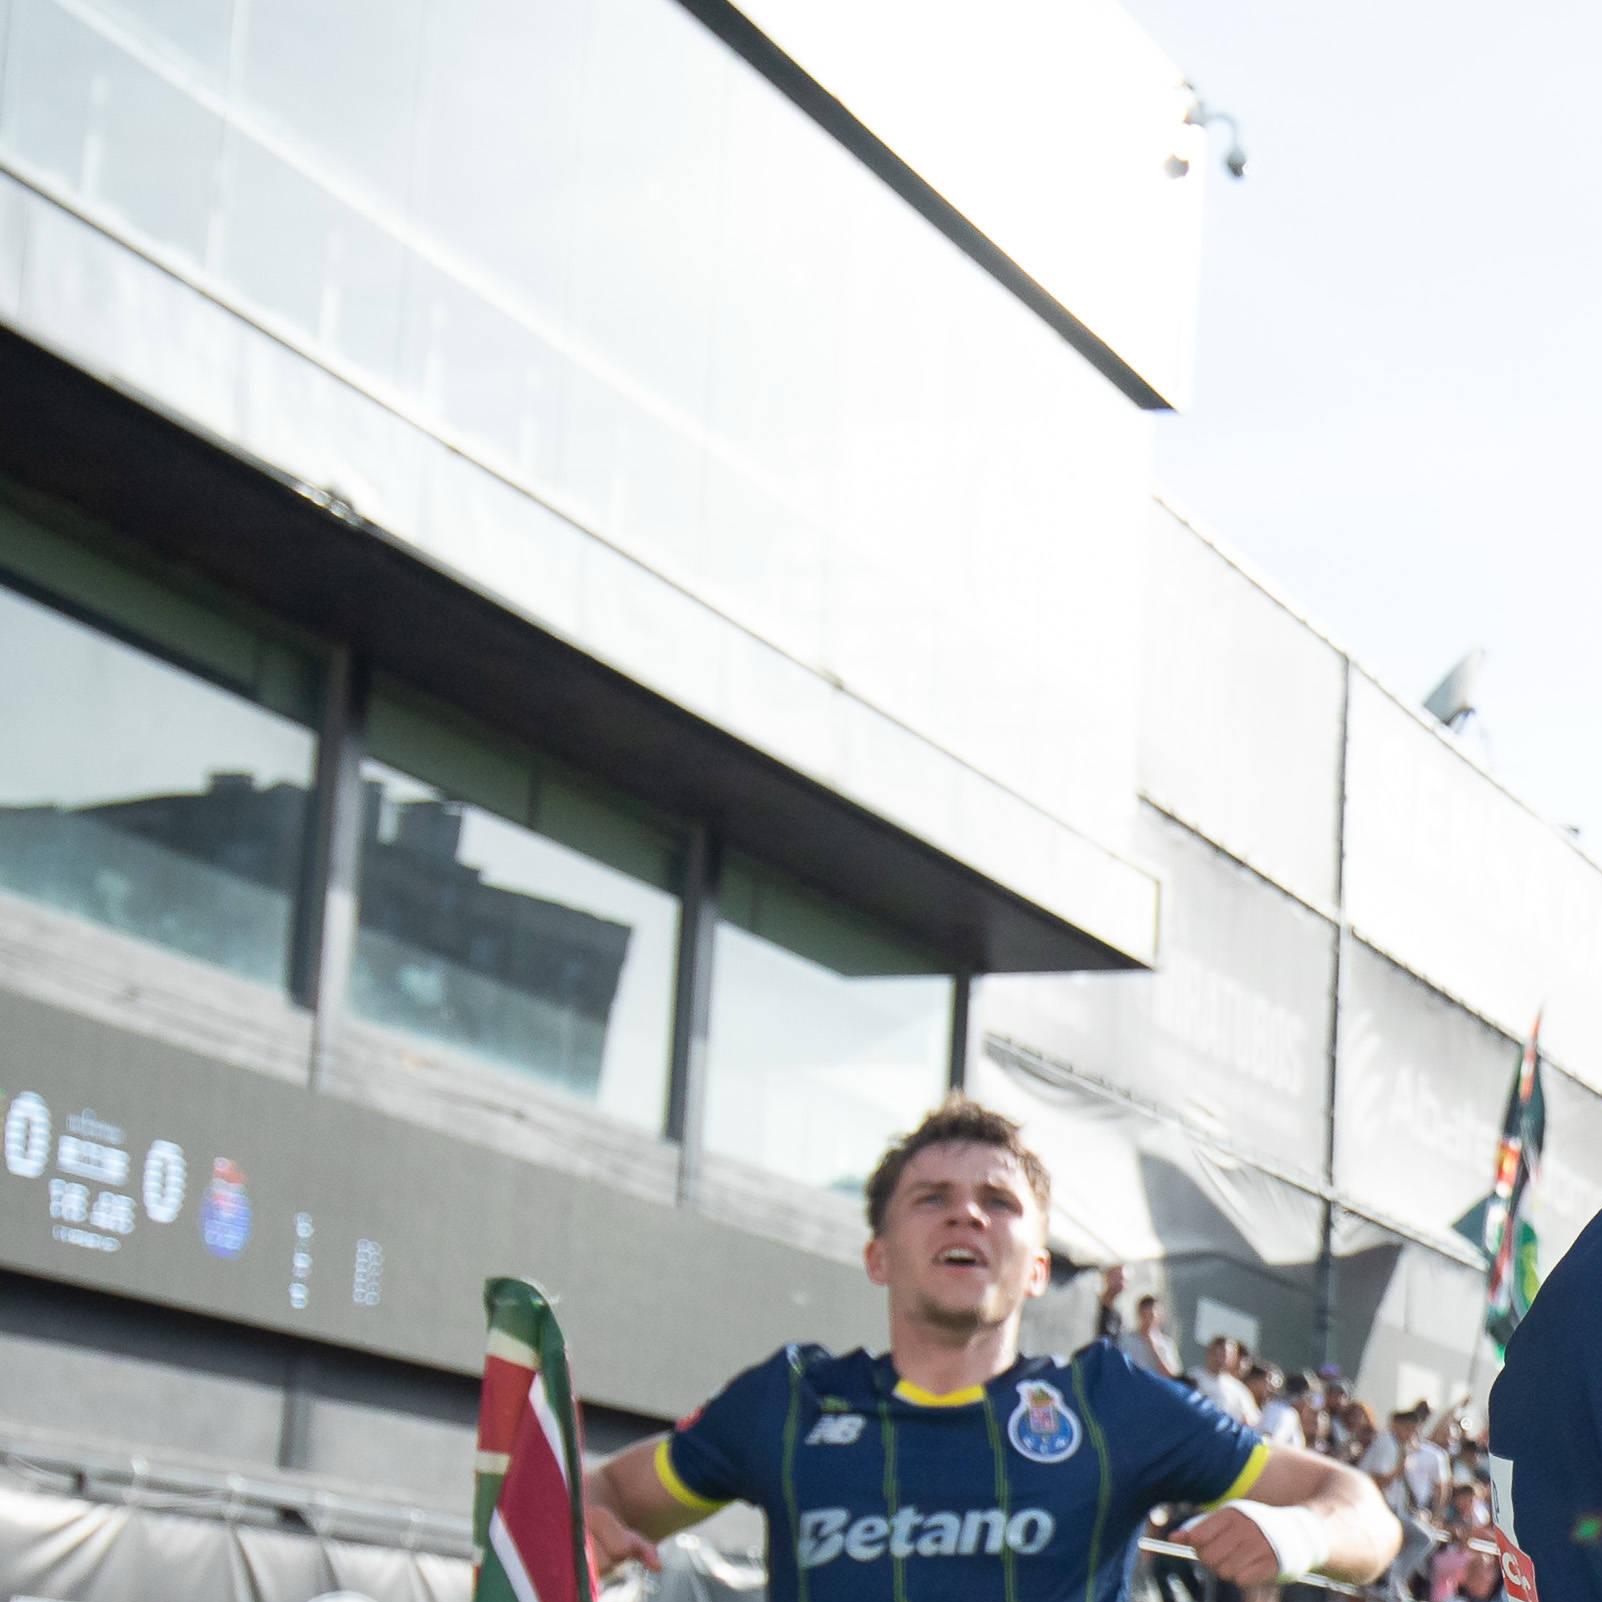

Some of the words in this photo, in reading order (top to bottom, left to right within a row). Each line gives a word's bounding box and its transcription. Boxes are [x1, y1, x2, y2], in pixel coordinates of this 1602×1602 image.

[5, 1090, 52, 1179] 0
[142, 1139, 187, 1223] 0
[800, 1503, 1056, 1568] Betano
